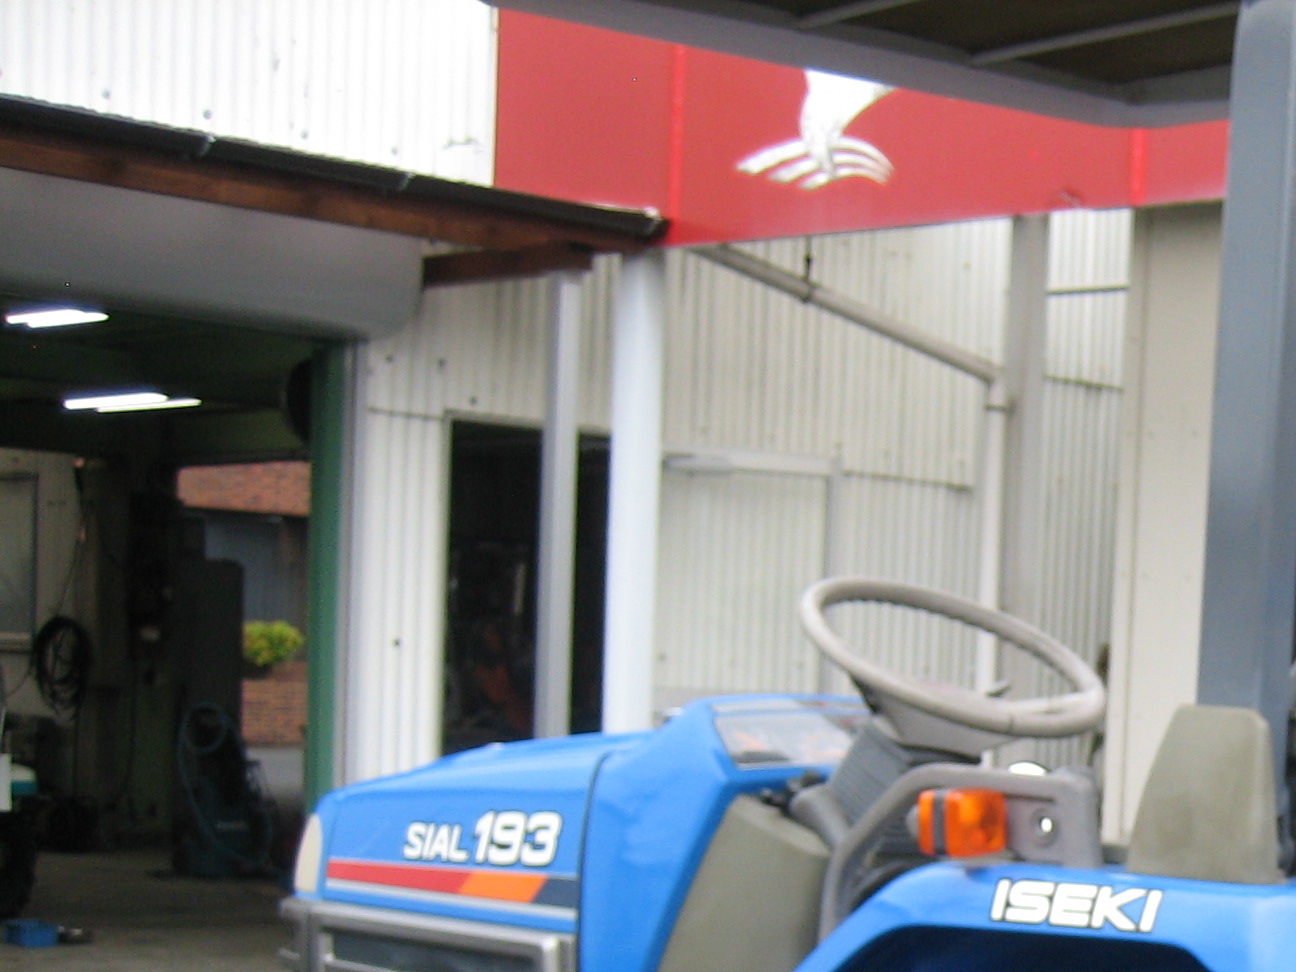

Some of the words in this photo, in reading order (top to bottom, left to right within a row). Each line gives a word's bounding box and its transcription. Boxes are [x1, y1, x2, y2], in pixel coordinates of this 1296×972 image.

[403, 822, 469, 862] SIAL
[473, 810, 562, 866] 193
[990, 878, 1163, 933] ISEKI
